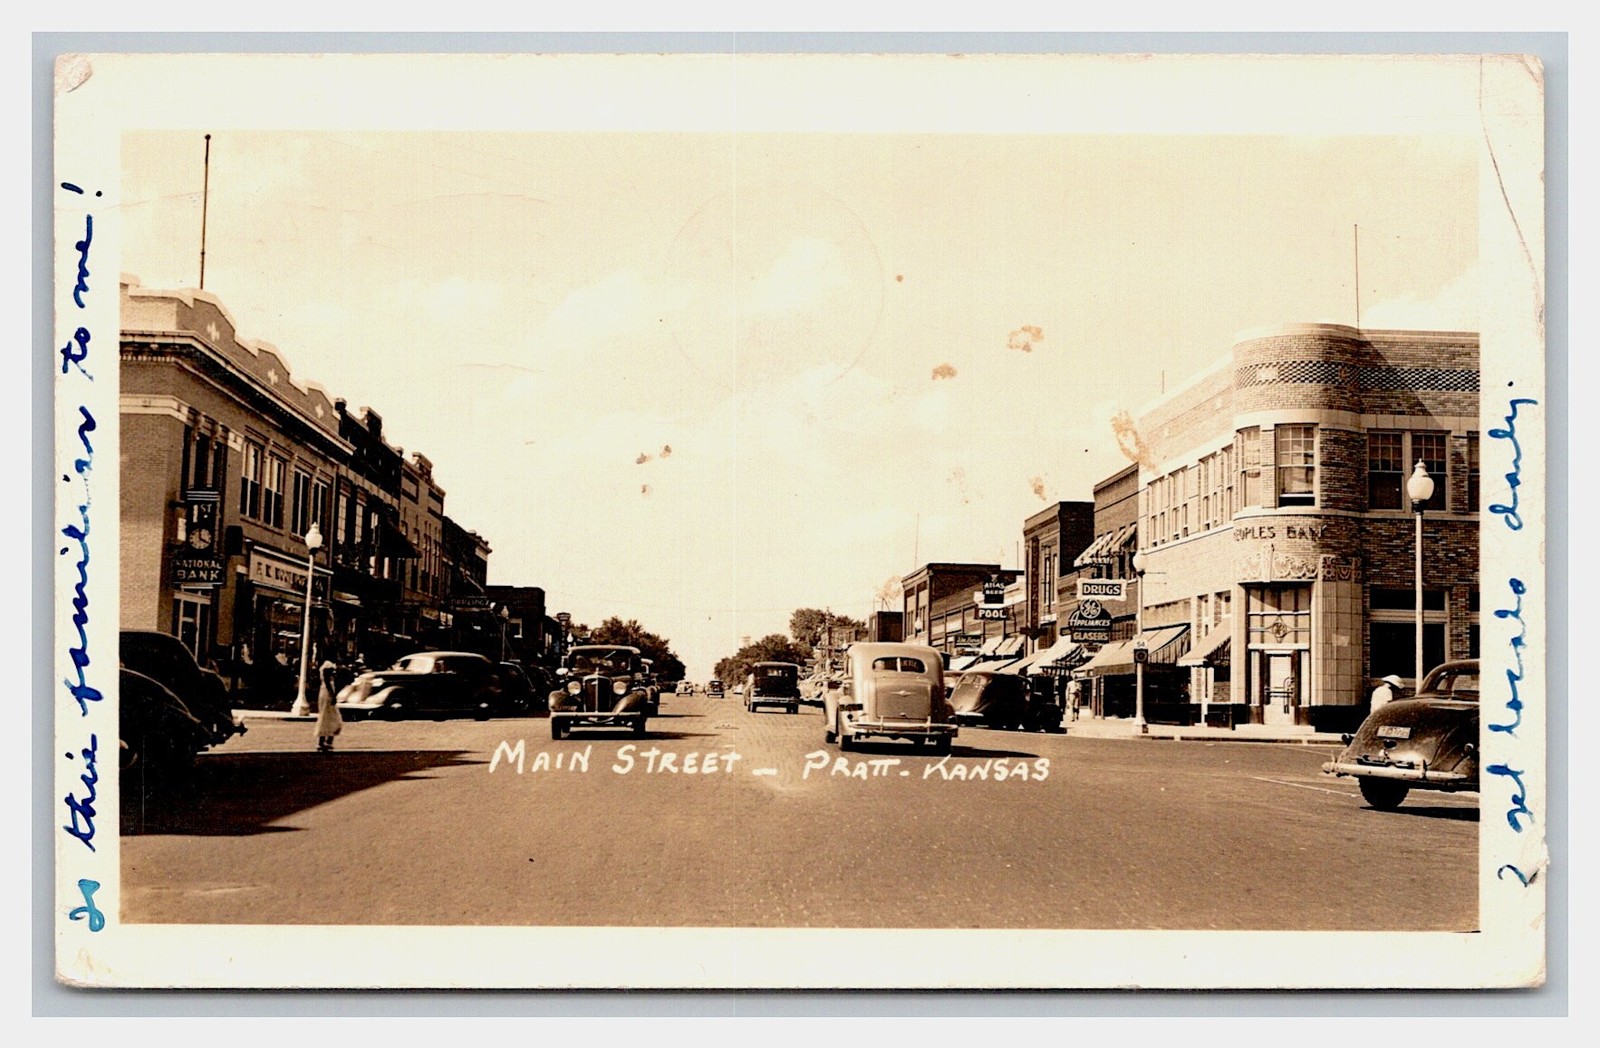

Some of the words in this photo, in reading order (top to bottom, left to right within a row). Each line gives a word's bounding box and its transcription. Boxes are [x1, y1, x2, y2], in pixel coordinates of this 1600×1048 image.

[60, 326, 94, 380] to
[175, 559, 222, 570] NATIONAL
[177, 568, 219, 580] BANK
[1083, 584, 1121, 595] DRUGS
[979, 609, 1007, 619] POOL
[1068, 610, 1111, 627] APPLIANCES
